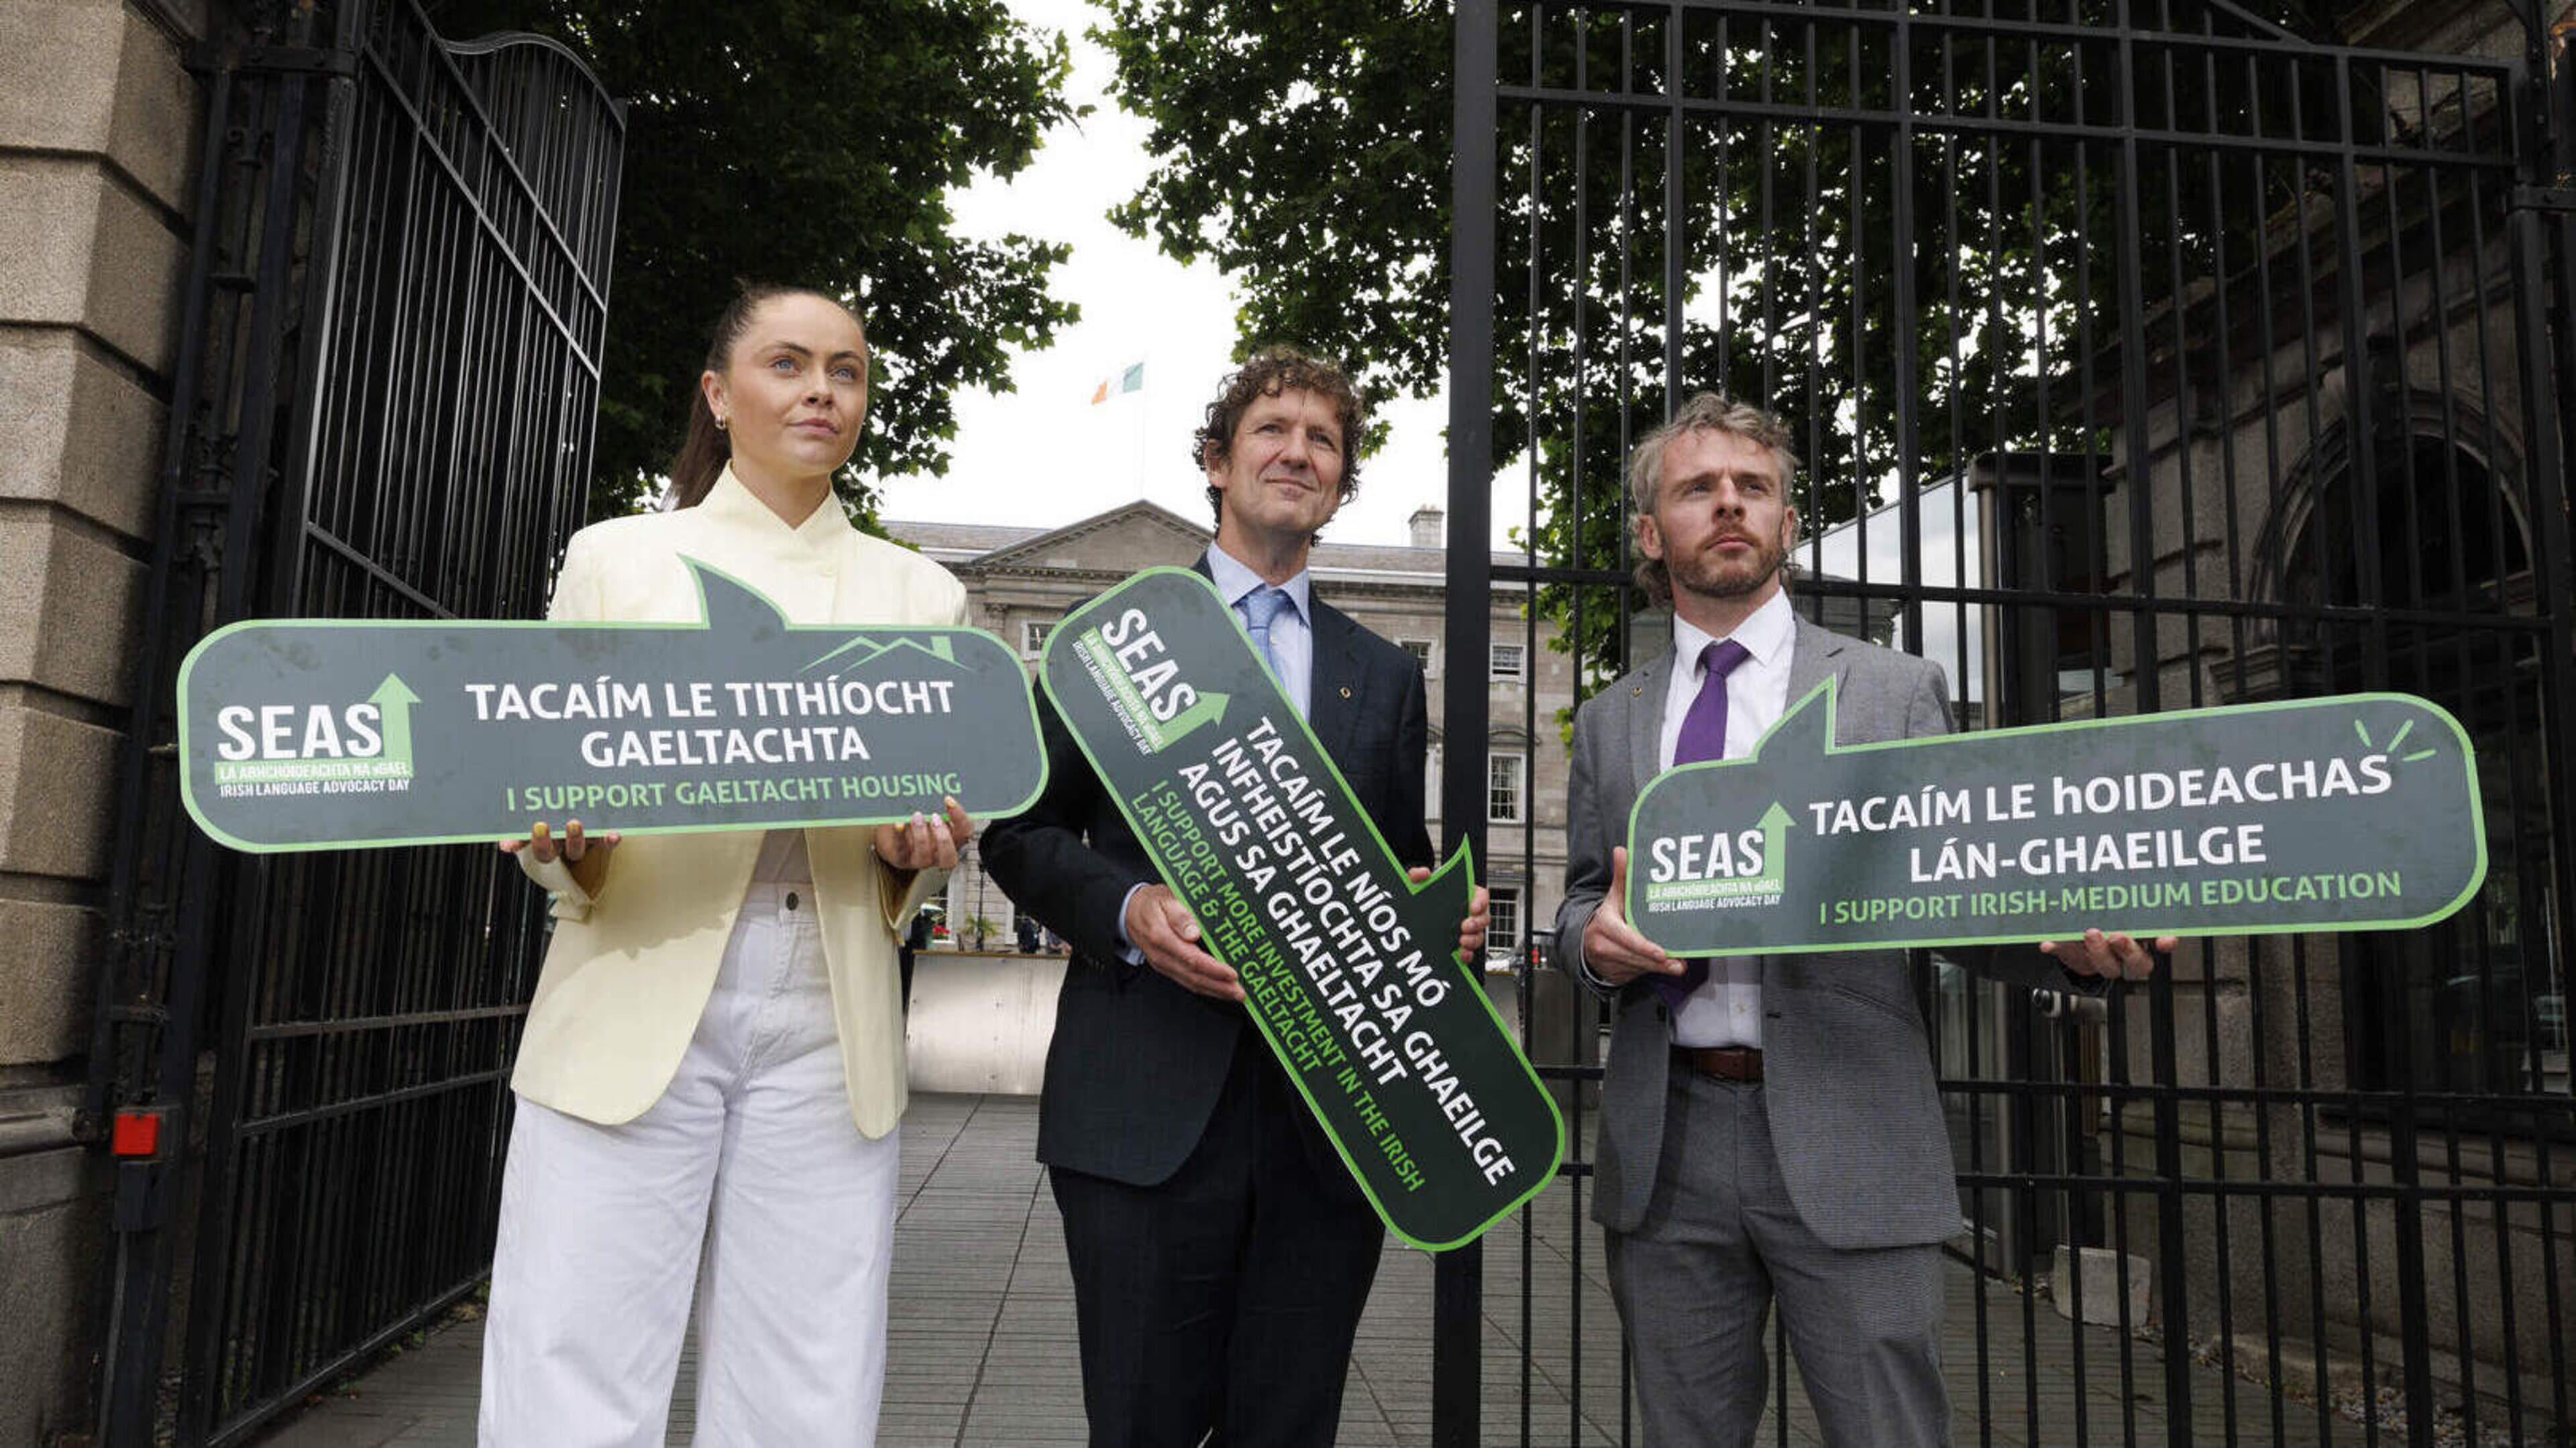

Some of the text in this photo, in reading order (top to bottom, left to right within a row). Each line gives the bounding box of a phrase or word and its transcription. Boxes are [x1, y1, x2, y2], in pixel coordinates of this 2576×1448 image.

[1102, 608, 1196, 721] SEAS
[465, 675, 954, 720] TACAÍM LE TITHÍOCHT
[217, 704, 382, 761] SEAS
[581, 726, 870, 767] GAELTACHTA
[220, 777, 410, 797] IRISH LANGUAGE ADVOCACY DAY
[507, 773, 961, 811] I SUPPORT GAELTACHT HOUSING
[1809, 755, 2392, 836] TACAÍM LE hOIDEACHAS
[1246, 716, 1451, 1007] TACAÍM LE NÍOS MÓ
[1650, 830, 1764, 883] SEAS
[1911, 824, 2267, 883] LÁN-GHAEILGE
[1178, 763, 1408, 1084] AGUS SA GHAELTACHT
[1820, 871, 2401, 924] I SUPPORT IRISH-MEDIUM EDUCATION
[1132, 792, 1322, 1071] LANGUAGE & THE GAELTACHT
[1151, 780, 1425, 1192] I SUPPORT MORE INVESTMENT IN THE IRISH
[1212, 737, 1515, 1186] INFHEISTÍOCHTA SA GHAEILGE
